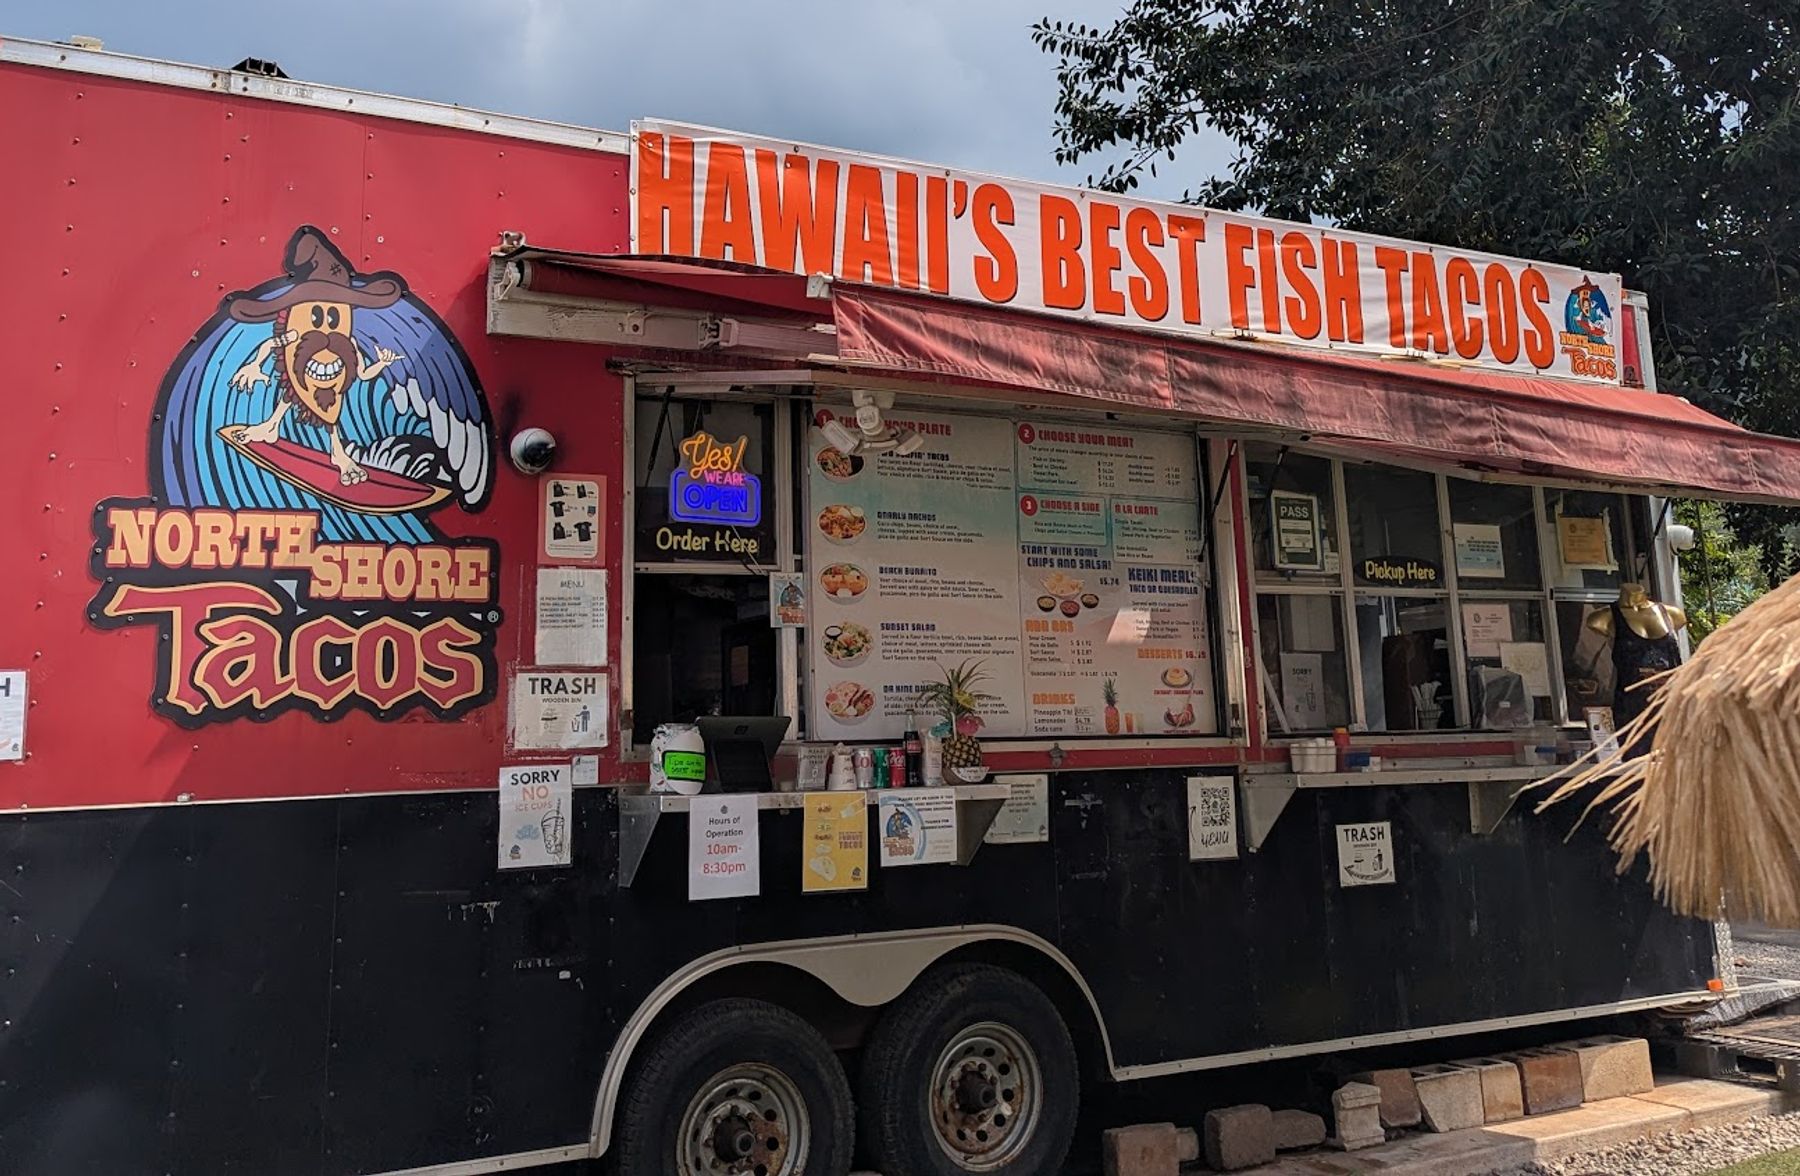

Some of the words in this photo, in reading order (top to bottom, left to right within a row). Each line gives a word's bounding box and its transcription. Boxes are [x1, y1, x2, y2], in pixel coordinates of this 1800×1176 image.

[636, 131, 1017, 303] HAWAII'S
[1041, 194, 1206, 325] BEST
[1225, 224, 1365, 343] FISH
[1375, 243, 1555, 369] TACOS
[919, 422, 952, 436] PLATE
[1038, 430, 1076, 443] CHOOSE
[1078, 433, 1105, 446] YOUR
[1107, 436, 1134, 448] MEAT
[682, 434, 748, 479] Yes!
[927, 452, 950, 461] TACOS
[684, 484, 748, 513] OPEN
[1040, 500, 1073, 510] CHOOSE
[1081, 502, 1100, 512] SIDE
[1123, 505, 1133, 514] LA
[1134, 506, 1158, 516] CARTE
[1280, 506, 1310, 518] PASS
[908, 512, 936, 521] NACHOS
[107, 509, 320, 570] NORTH
[656, 527, 710, 552] Order
[715, 530, 760, 554] Here
[1021, 545, 1048, 555] START
[1049, 546, 1072, 556] WITH
[1074, 547, 1099, 557] SOME
[1027, 557, 1055, 568] CHIPS
[1057, 558, 1077, 569] AND
[1079, 559, 1112, 570] SALSA!
[310, 546, 490, 601] SHORE
[879, 567, 904, 575] BEACH
[905, 568, 937, 576] BURRITO
[1128, 568, 1158, 582] KEIKI
[1365, 560, 1406, 585] Pickup
[1407, 562, 1436, 580] Here
[561, 580, 584, 590] MENU
[1129, 584, 1146, 593] TACO
[1148, 585, 1157, 594] OR
[880, 622, 910, 631] SUNSET
[911, 623, 937, 632] SALAD
[105, 582, 484, 714] Tacos
[1138, 648, 1183, 660] DESSERTS
[528, 677, 596, 695] TRASH
[1033, 693, 1076, 705] DRINKS
[511, 770, 560, 786] SORRY
[522, 786, 549, 800] NO
[515, 803, 530, 812] ICE
[531, 802, 552, 811] CUPS
[708, 817, 731, 826] Hours
[732, 816, 741, 824] of
[706, 829, 744, 840] Operation
[1201, 831, 1229, 848] MENU
[1344, 826, 1385, 842] TRASH
[704, 862, 746, 875] 8:30pm
